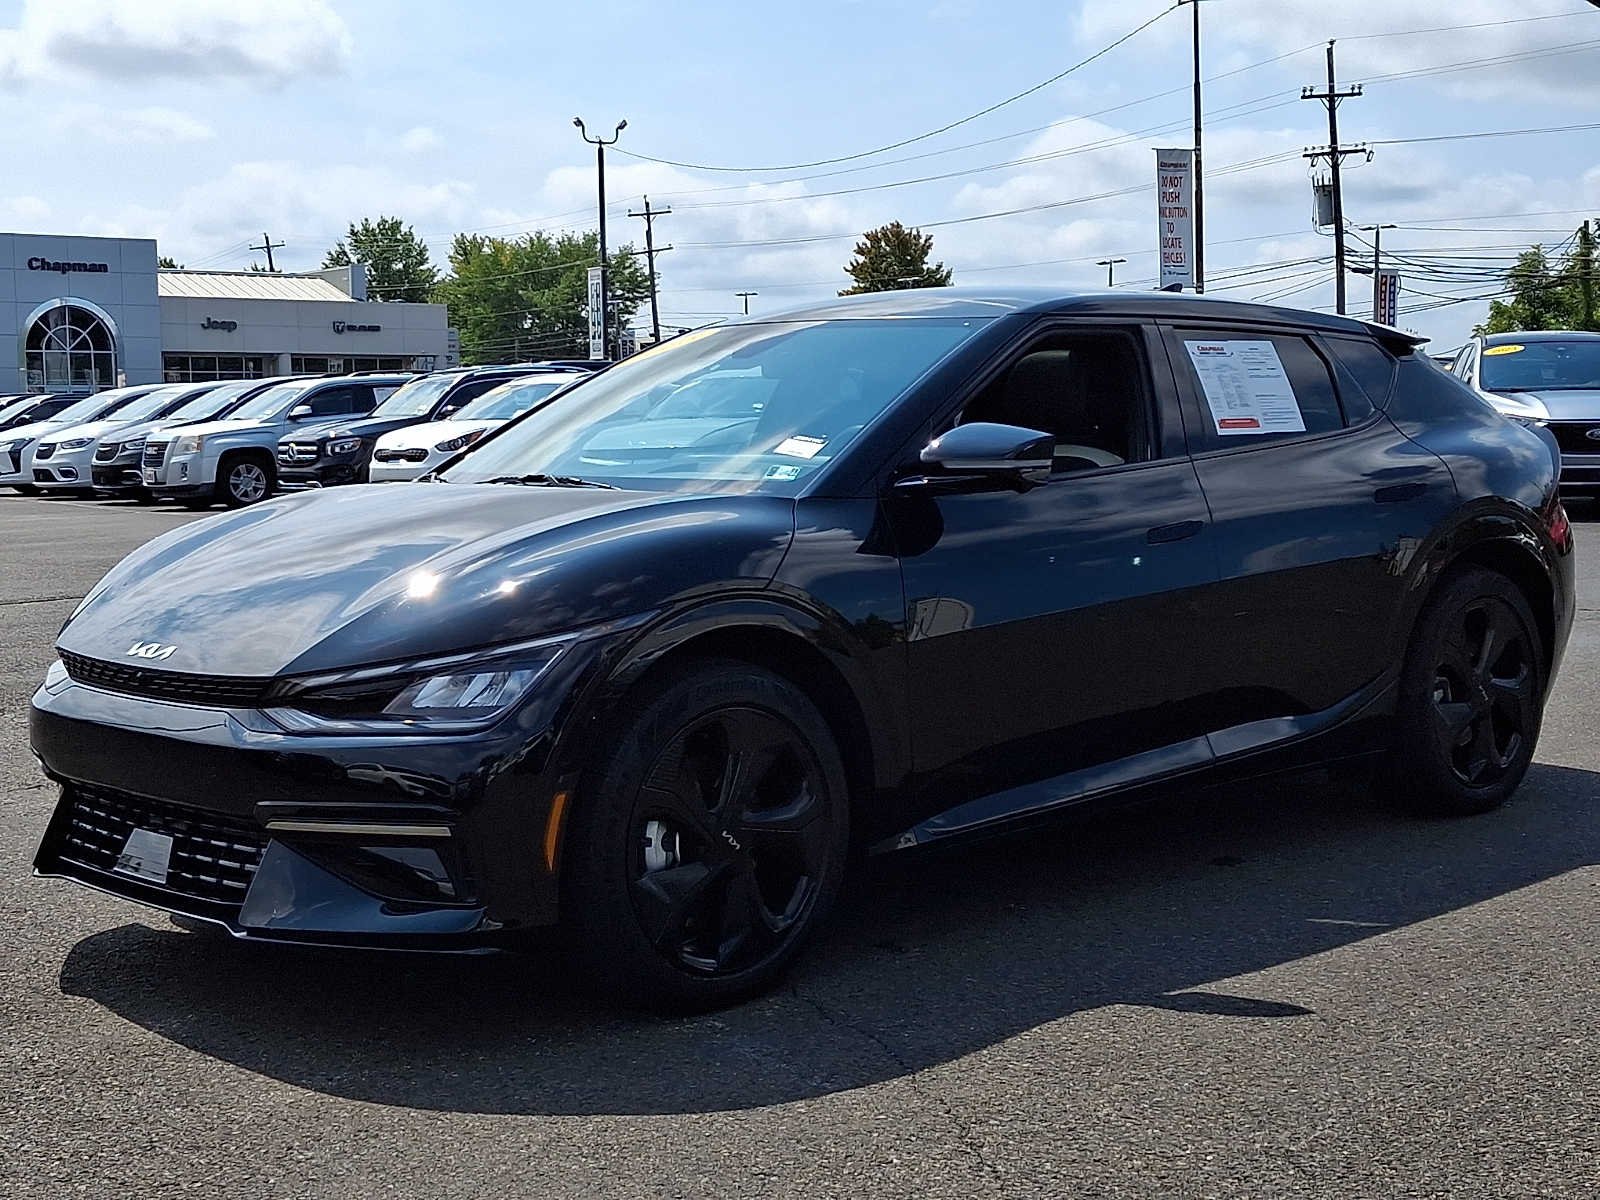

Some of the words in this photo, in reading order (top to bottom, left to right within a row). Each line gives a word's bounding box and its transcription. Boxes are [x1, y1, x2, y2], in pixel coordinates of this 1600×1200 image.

[1167, 221, 1175, 234] TO
[27, 256, 109, 274] Chapman
[200, 316, 238, 333] Jeep
